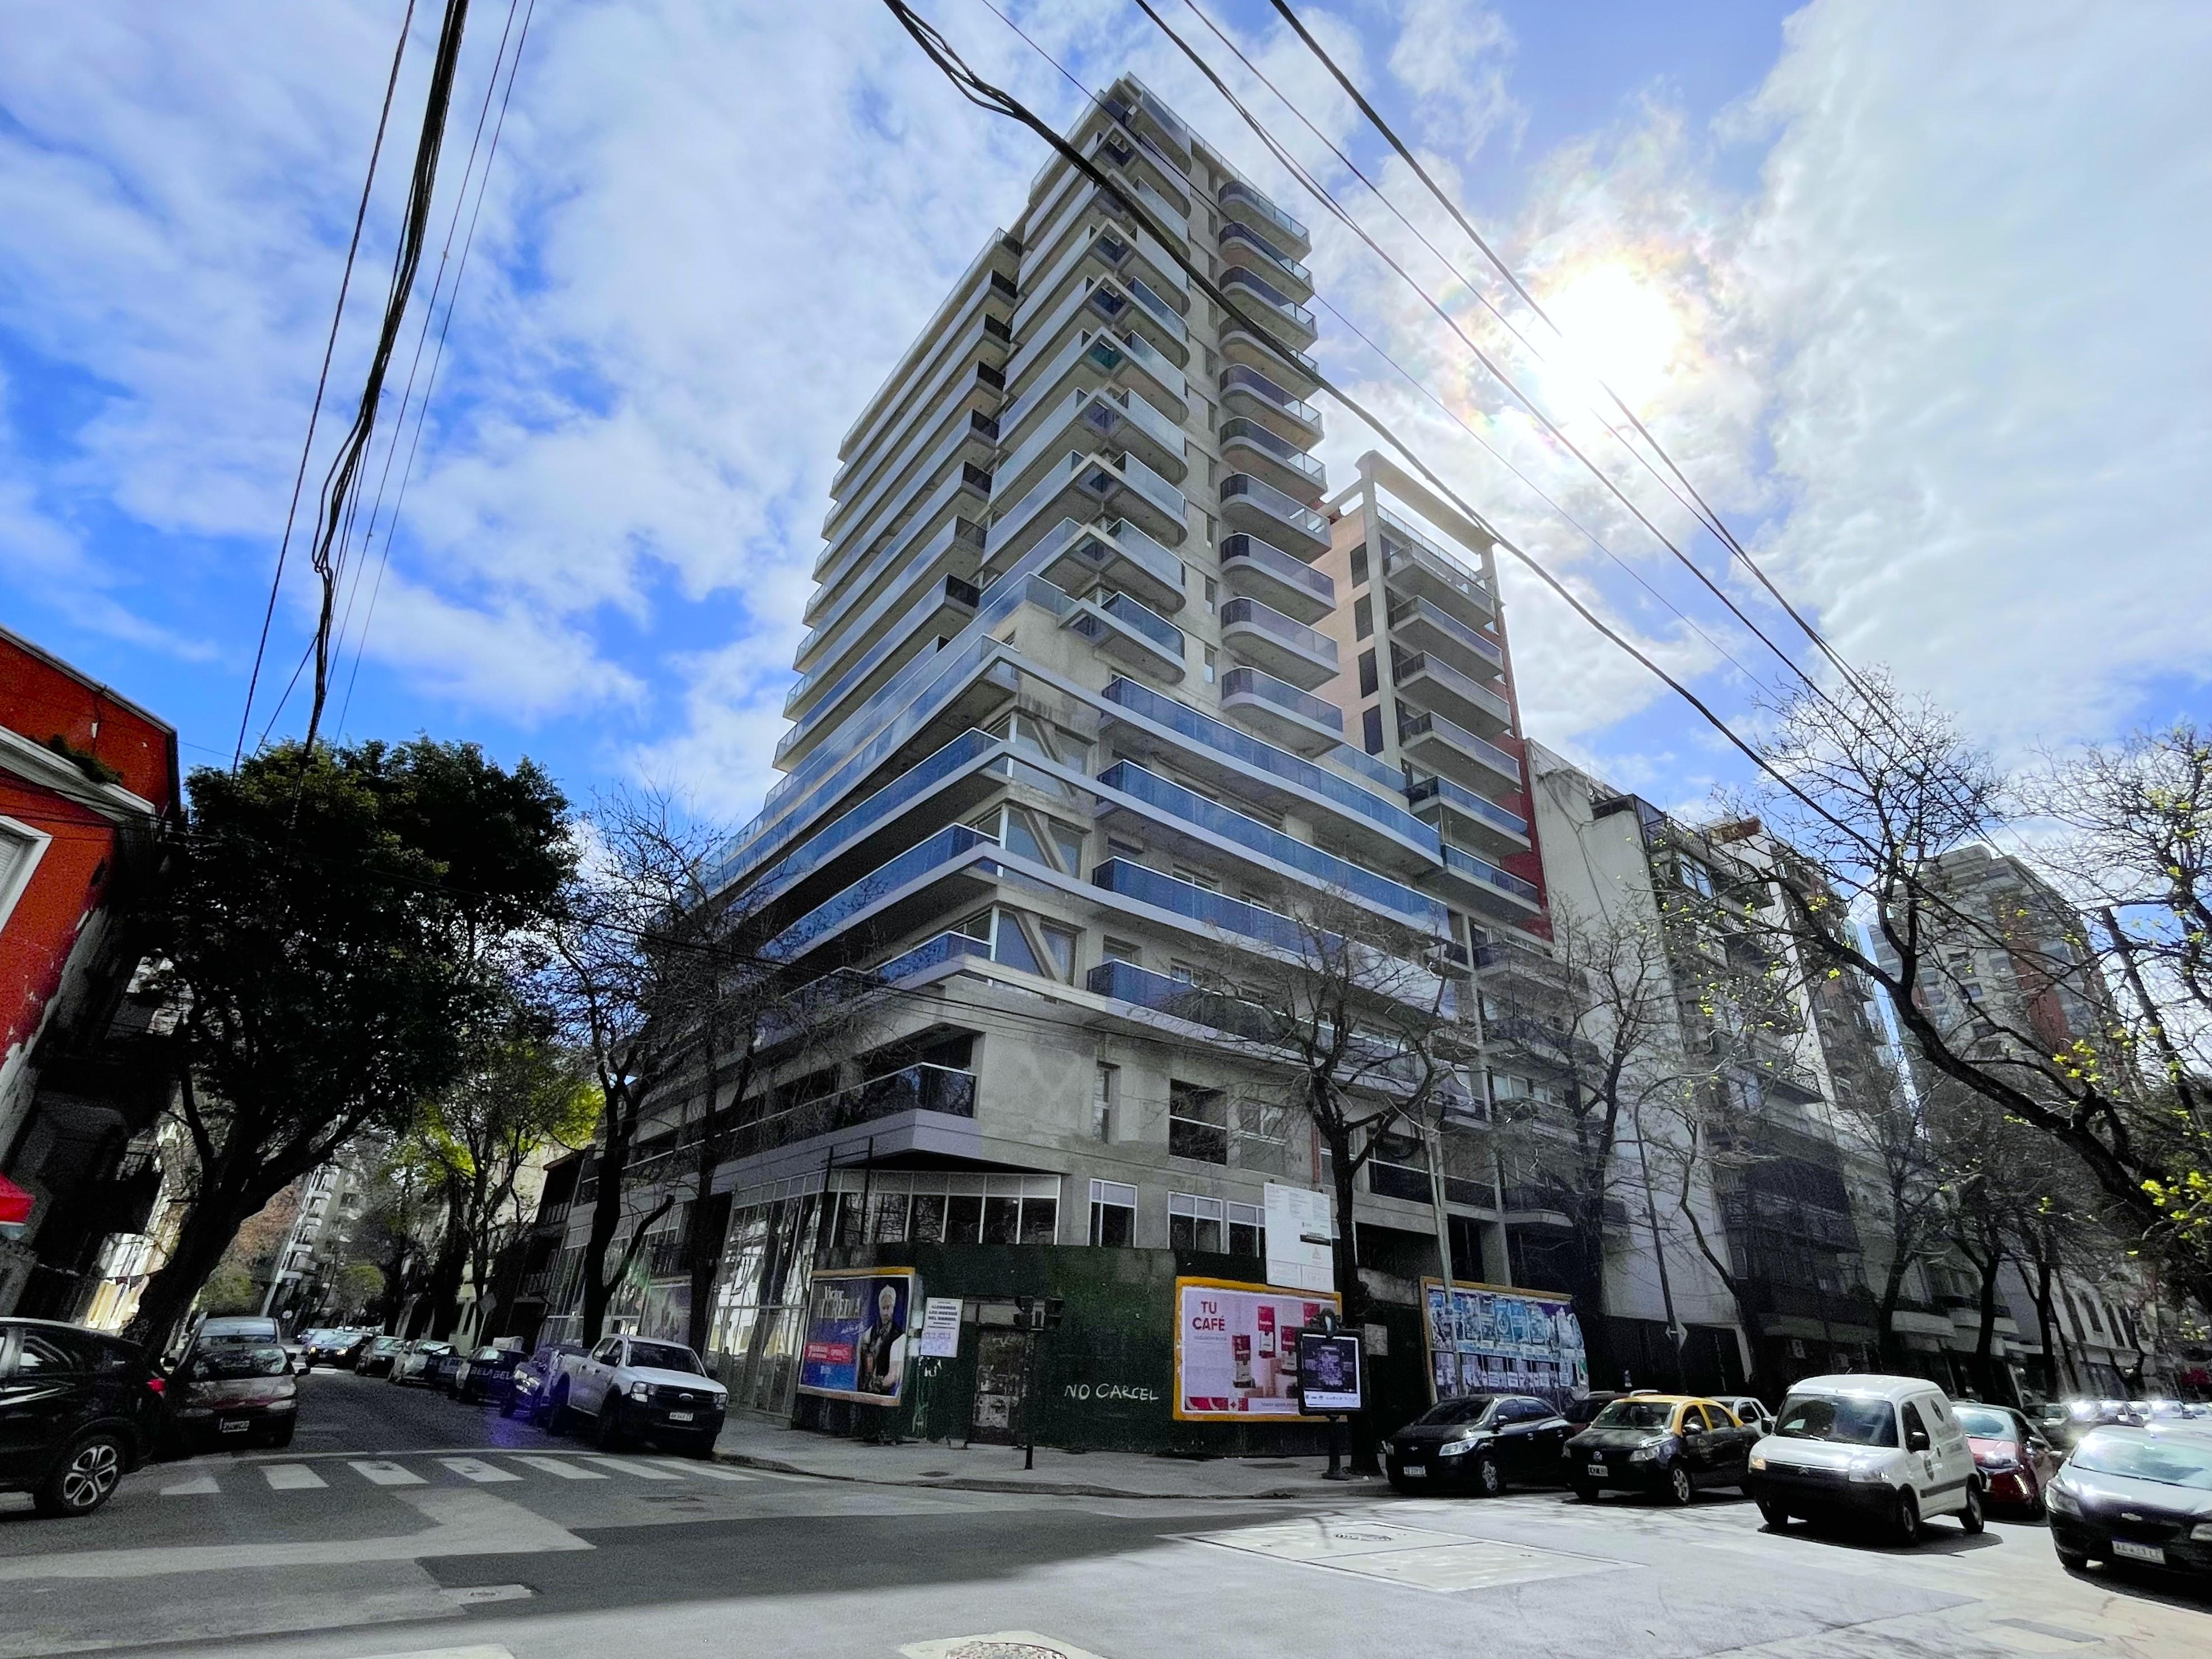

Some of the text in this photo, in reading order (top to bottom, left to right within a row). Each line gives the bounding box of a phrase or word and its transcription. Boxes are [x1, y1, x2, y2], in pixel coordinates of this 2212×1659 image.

[1201, 1301, 1217, 1314] TU
[1192, 1315, 1225, 1331] CAFÉ
[1064, 1383, 1159, 1402] NO CARCEL
